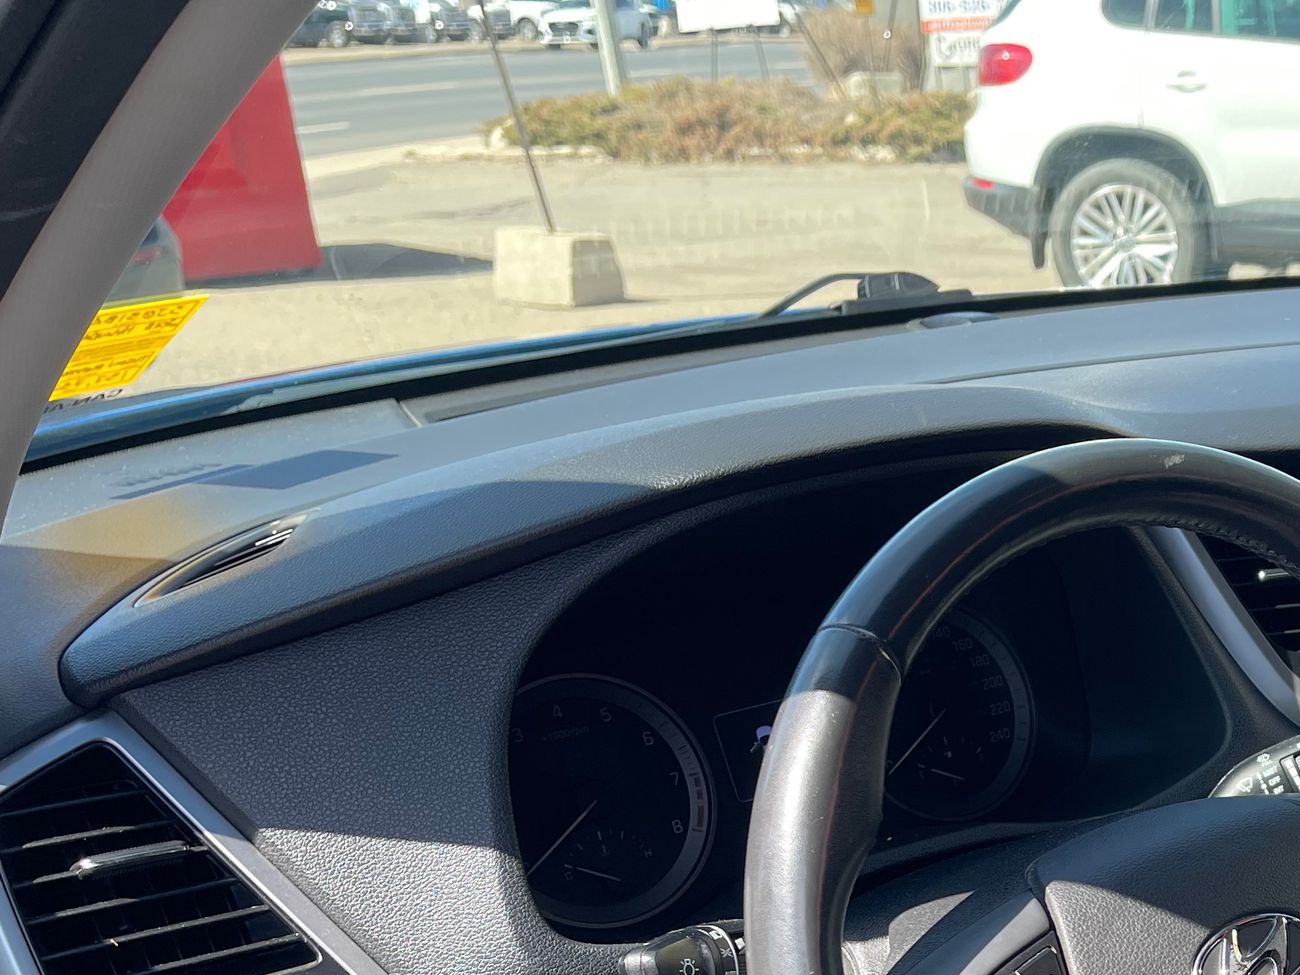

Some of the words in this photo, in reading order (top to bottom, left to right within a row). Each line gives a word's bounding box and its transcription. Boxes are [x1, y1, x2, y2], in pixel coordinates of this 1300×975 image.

[952, 638, 974, 651] 160
[970, 654, 991, 667] 180
[983, 675, 1004, 689] 200
[553, 706, 562, 718] 4
[601, 708, 612, 722] 5
[989, 701, 1012, 716] 220
[513, 729, 524, 743] 3
[643, 731, 653, 745] 6
[989, 729, 1011, 742] 240
[670, 772, 678, 785] 7
[1268, 775, 1281, 787] OFF
[672, 820, 683, 833] 8
